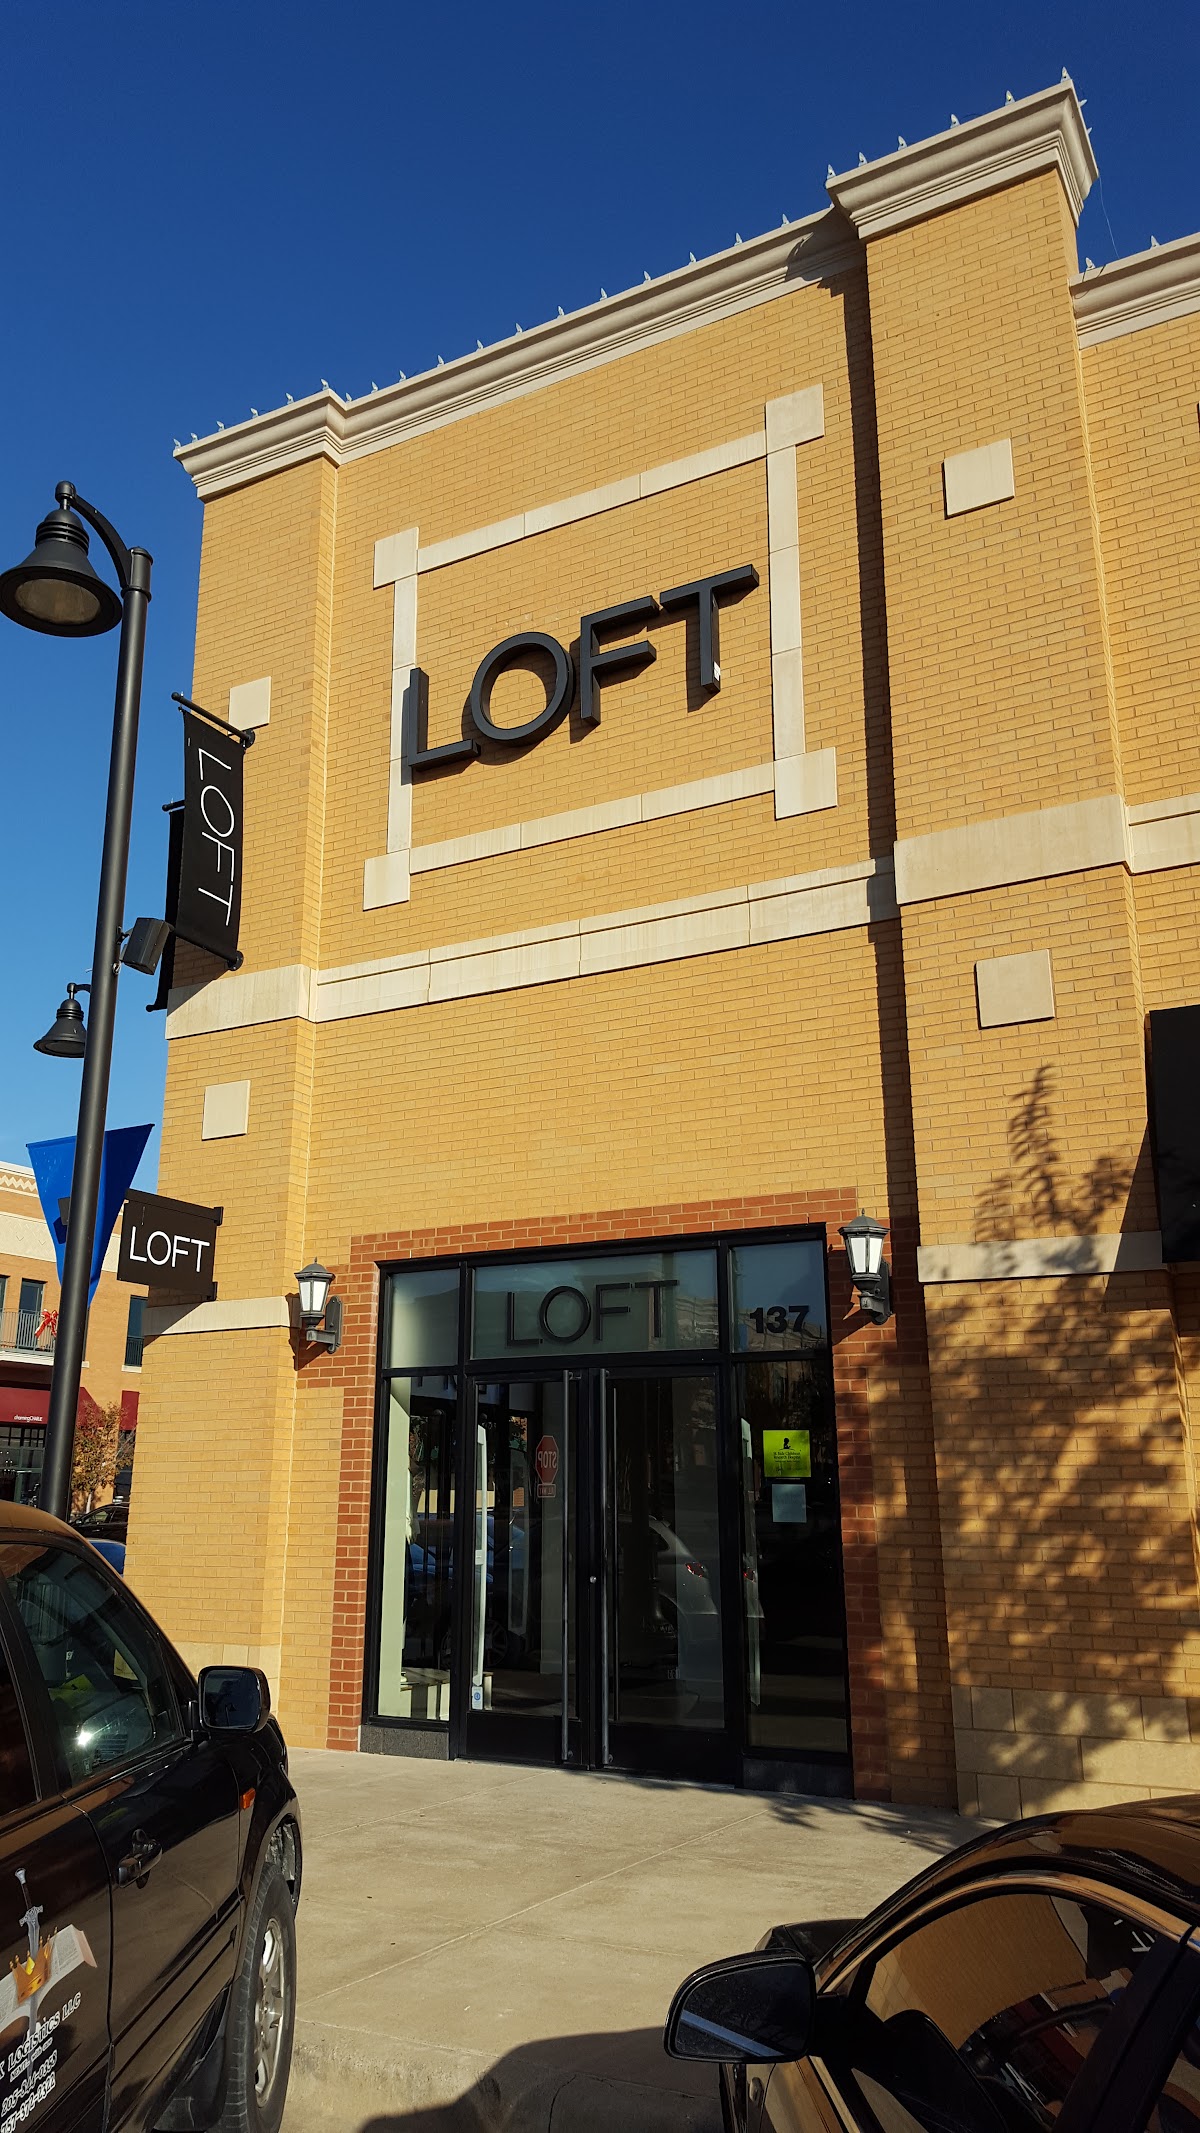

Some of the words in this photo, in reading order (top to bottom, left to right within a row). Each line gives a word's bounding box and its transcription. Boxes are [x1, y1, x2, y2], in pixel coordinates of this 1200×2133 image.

[408, 564, 760, 771] LOFT
[198, 748, 235, 926] LOFT
[129, 1226, 211, 1273] LOFT
[507, 1280, 680, 1346] LOFT
[749, 1305, 810, 1335] 137
[8, 2010, 60, 2072] LOGISTICS
[62, 1992, 81, 2021] LLC
